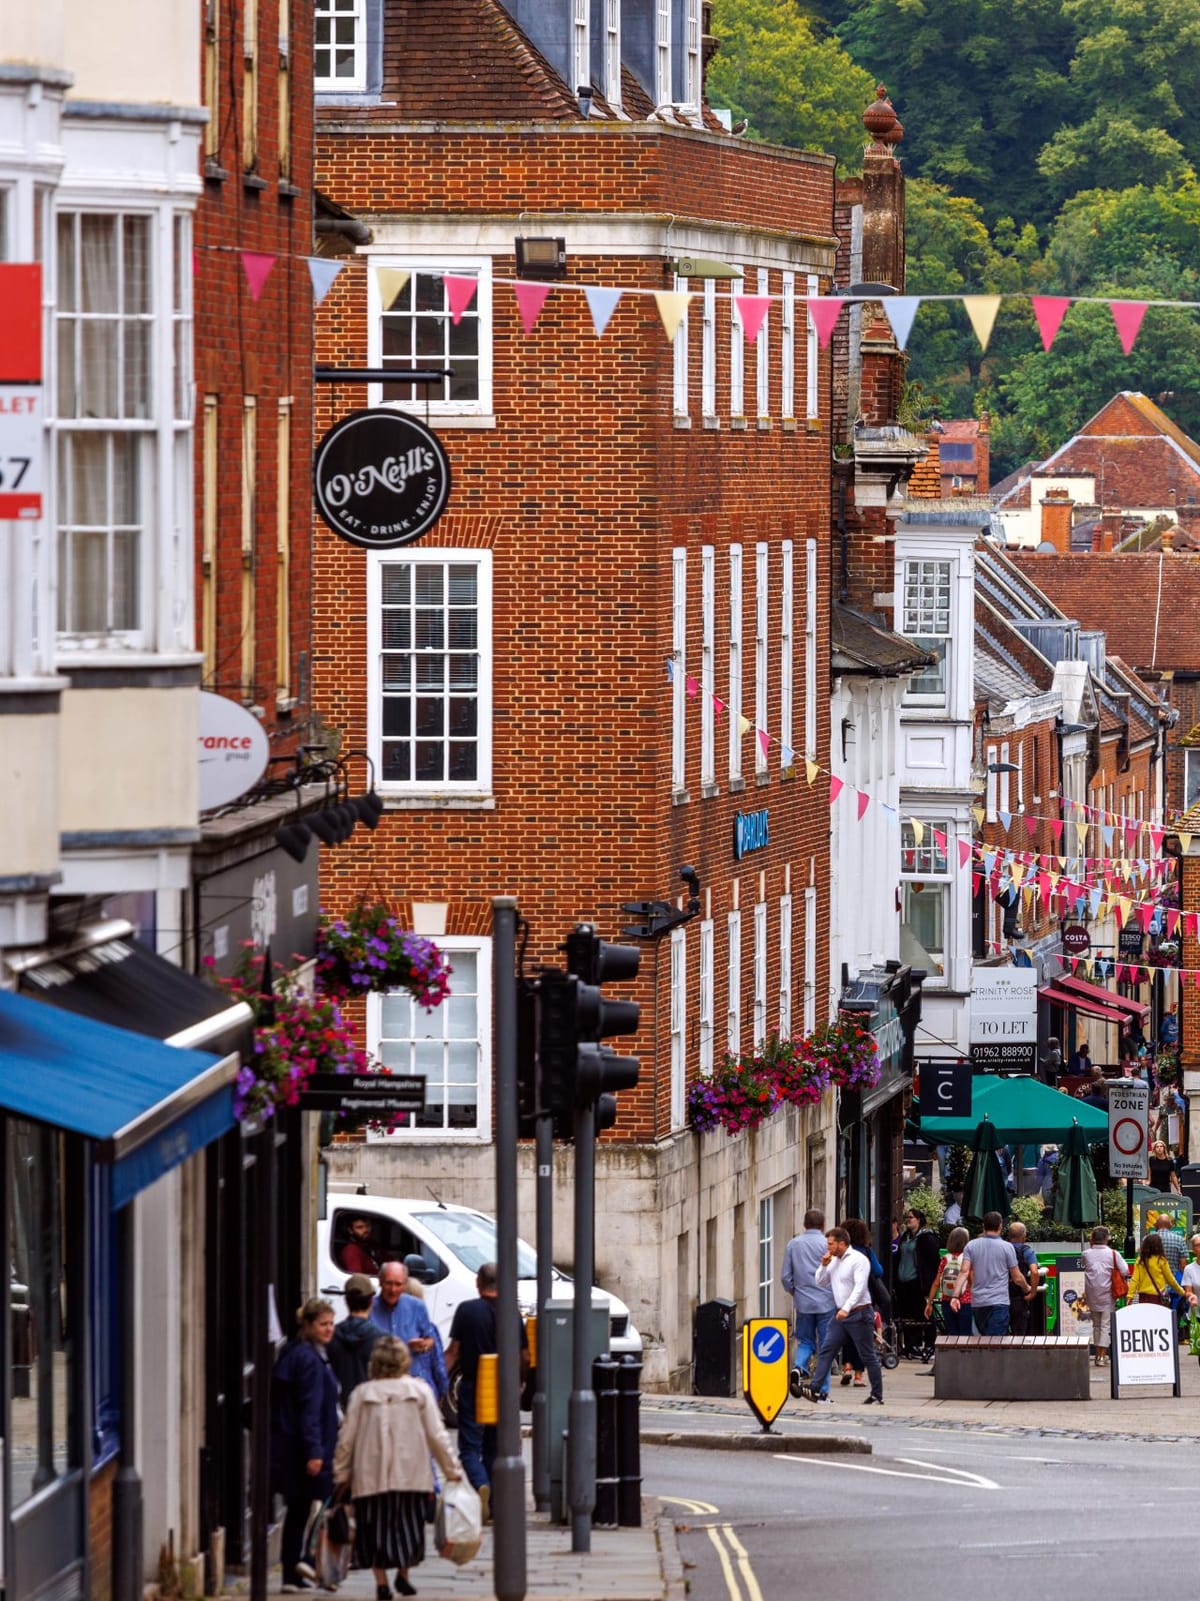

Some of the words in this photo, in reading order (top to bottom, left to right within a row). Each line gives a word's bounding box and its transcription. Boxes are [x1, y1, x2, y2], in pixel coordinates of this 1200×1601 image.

[0, 457, 31, 490] 7
[325, 446, 435, 506] O'Neill's
[338, 509, 362, 528] EAT
[370, 518, 412, 535] DRINK
[415, 476, 437, 516] ENJOY
[975, 987, 1008, 996] TRINITY
[1010, 986, 1034, 995] ROSE
[980, 1021, 999, 1035] TO
[1002, 1021, 1029, 1035] LET
[973, 1046, 1000, 1057] 01962
[1001, 1046, 1033, 1056] 888900
[937, 1081, 953, 1100] C
[1110, 1091, 1147, 1099] PEDESTRIAN
[1114, 1100, 1144, 1110] ZONE
[1120, 1328, 1170, 1353] BEN'S
